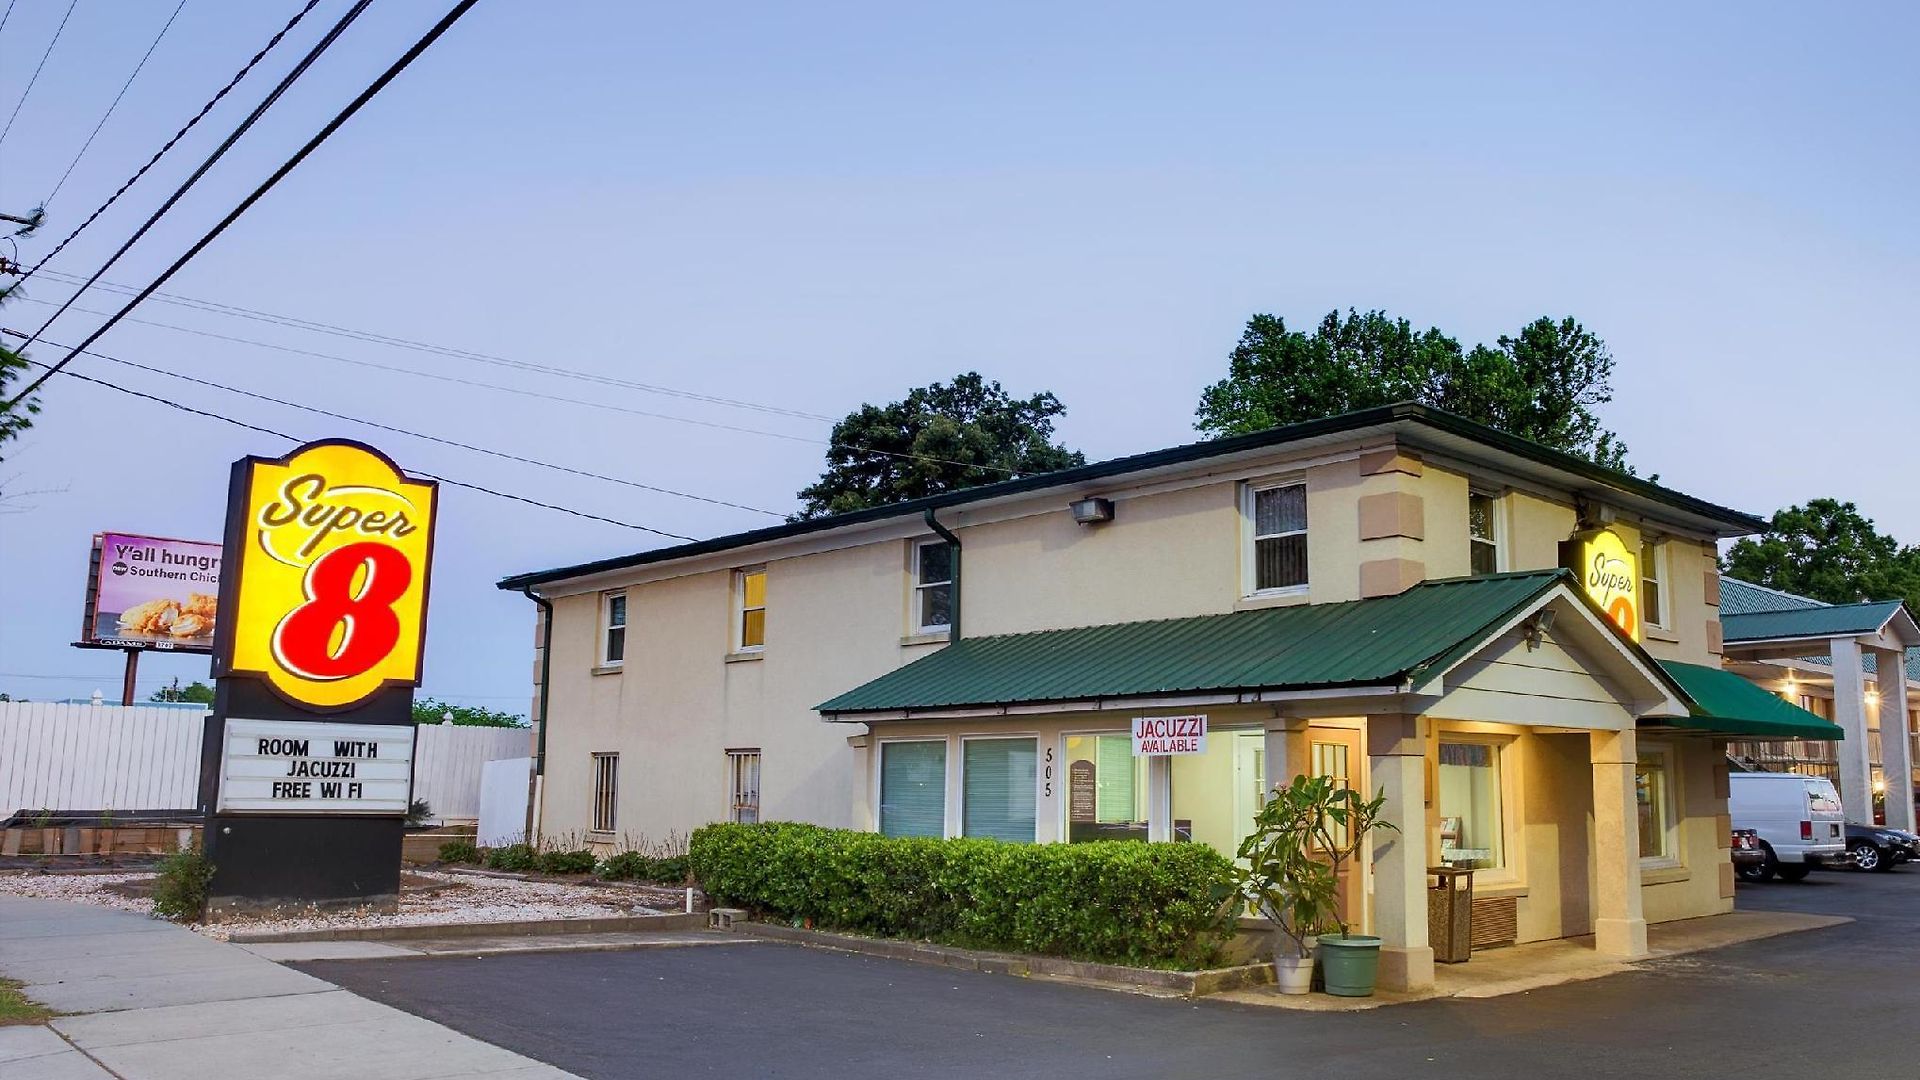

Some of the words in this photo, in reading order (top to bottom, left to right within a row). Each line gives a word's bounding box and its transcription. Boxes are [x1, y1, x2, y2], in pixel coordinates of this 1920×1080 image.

[261, 473, 418, 558] Super
[116, 545, 155, 562] Y'all
[162, 549, 221, 570] hungr
[130, 566, 186, 580] Southern
[190, 572, 220, 583] Chic
[1590, 553, 1633, 606] Super
[270, 541, 412, 683] 8
[1137, 718, 1202, 738] JACUZZI
[258, 739, 309, 756] ROOM
[334, 741, 378, 758] WITH
[1142, 739, 1197, 753] AVAILABLE
[287, 761, 355, 778] JACUZZI
[1045, 748, 1053, 797] 505
[272, 782, 311, 798] FREE
[320, 782, 341, 798] WI
[349, 783, 362, 799] FI
